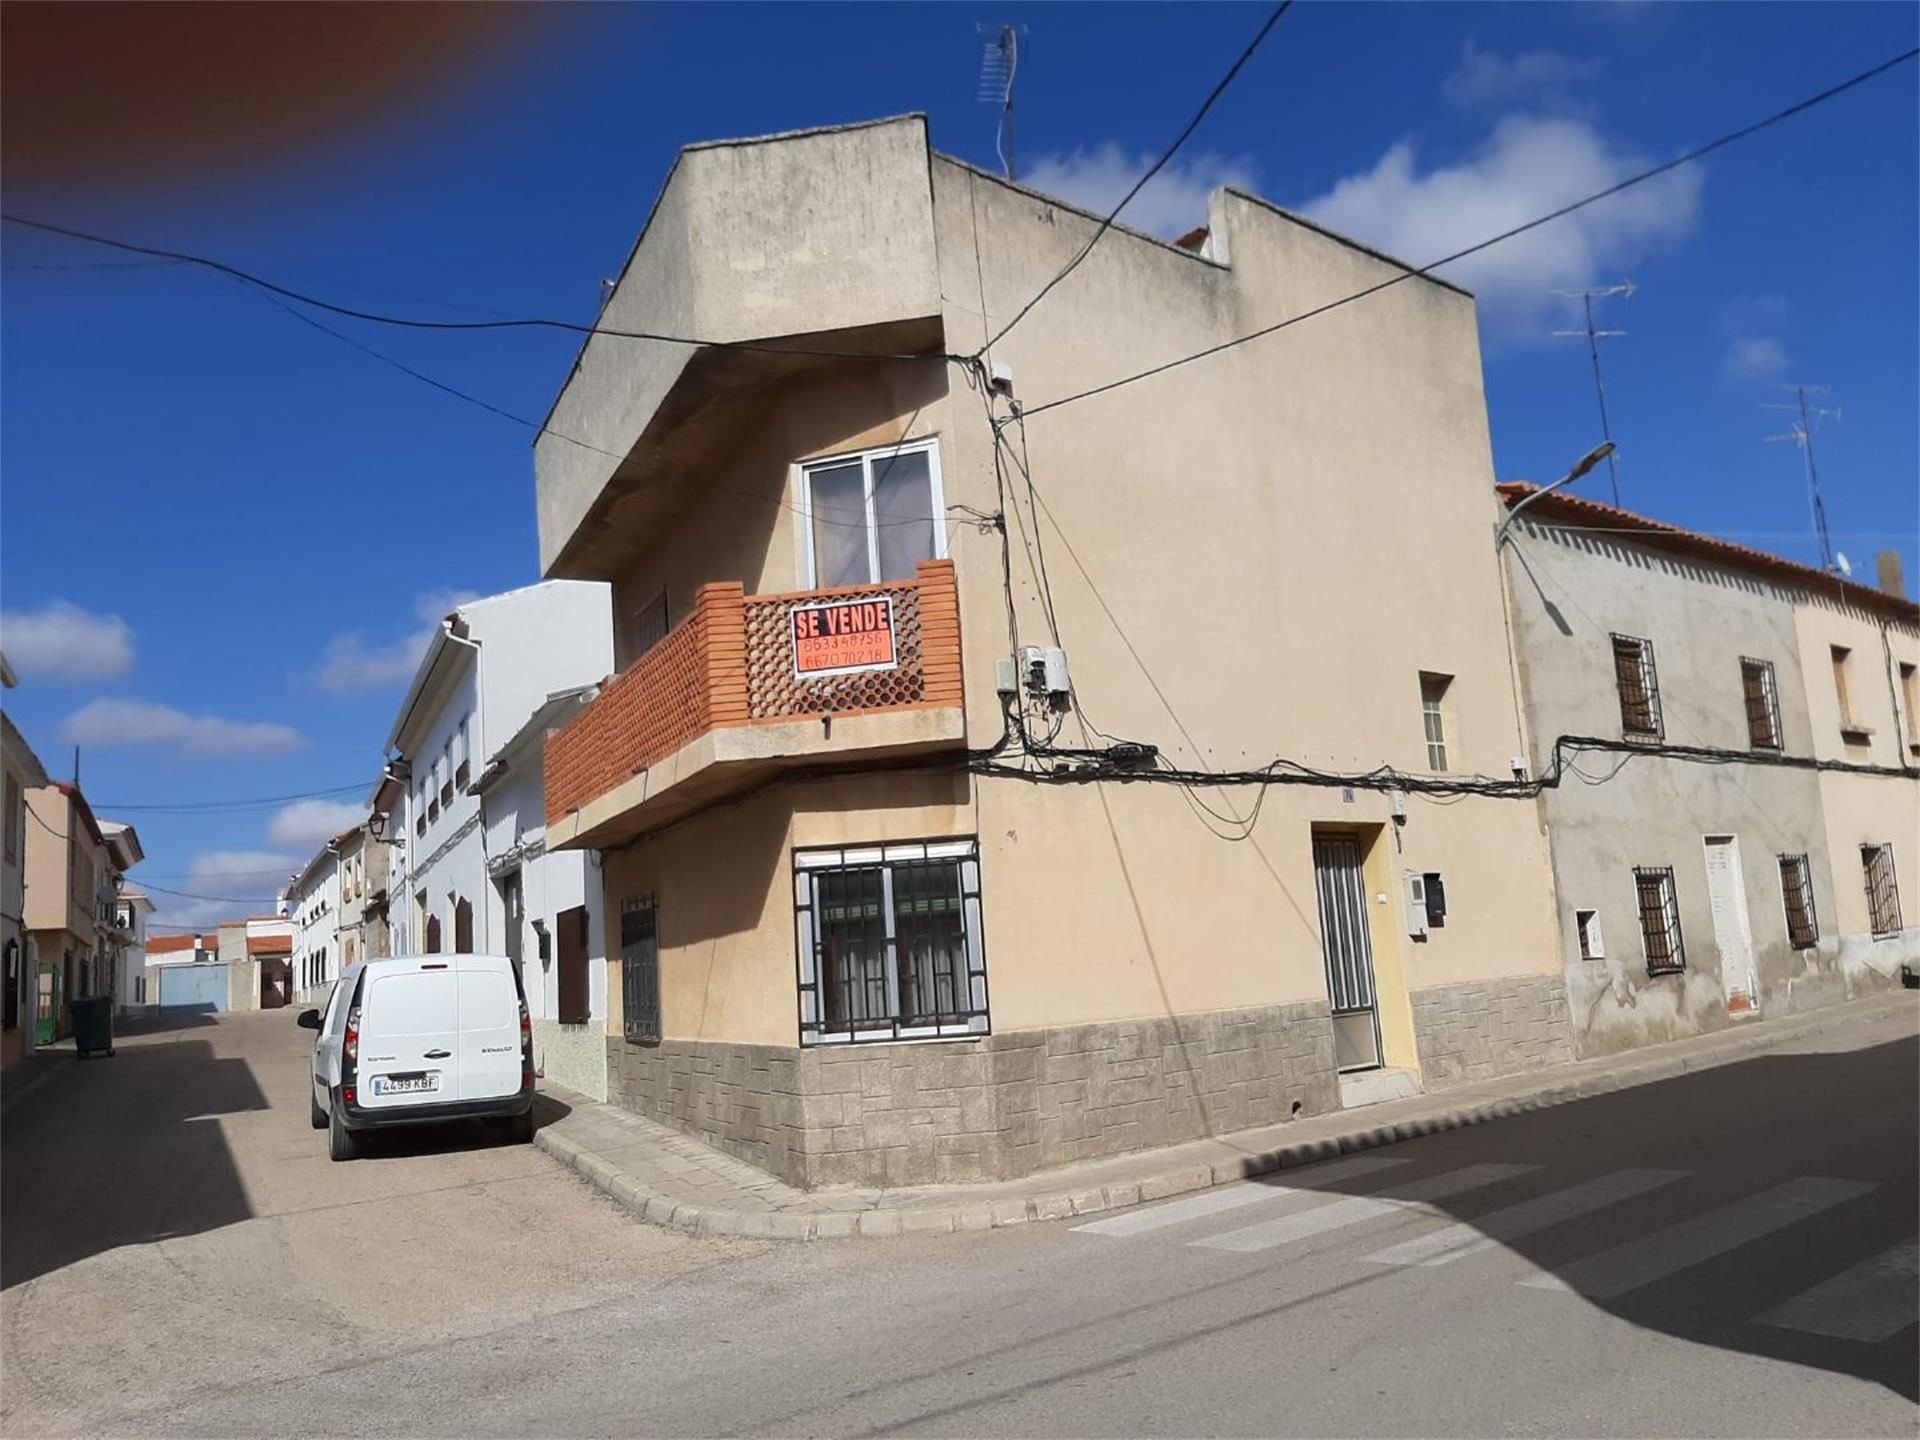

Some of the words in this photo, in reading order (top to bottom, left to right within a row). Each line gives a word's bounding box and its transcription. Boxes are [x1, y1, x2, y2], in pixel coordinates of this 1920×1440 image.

[797, 611, 819, 638] SE
[826, 603, 888, 634] VENDE
[383, 1079, 411, 1091] 4499
